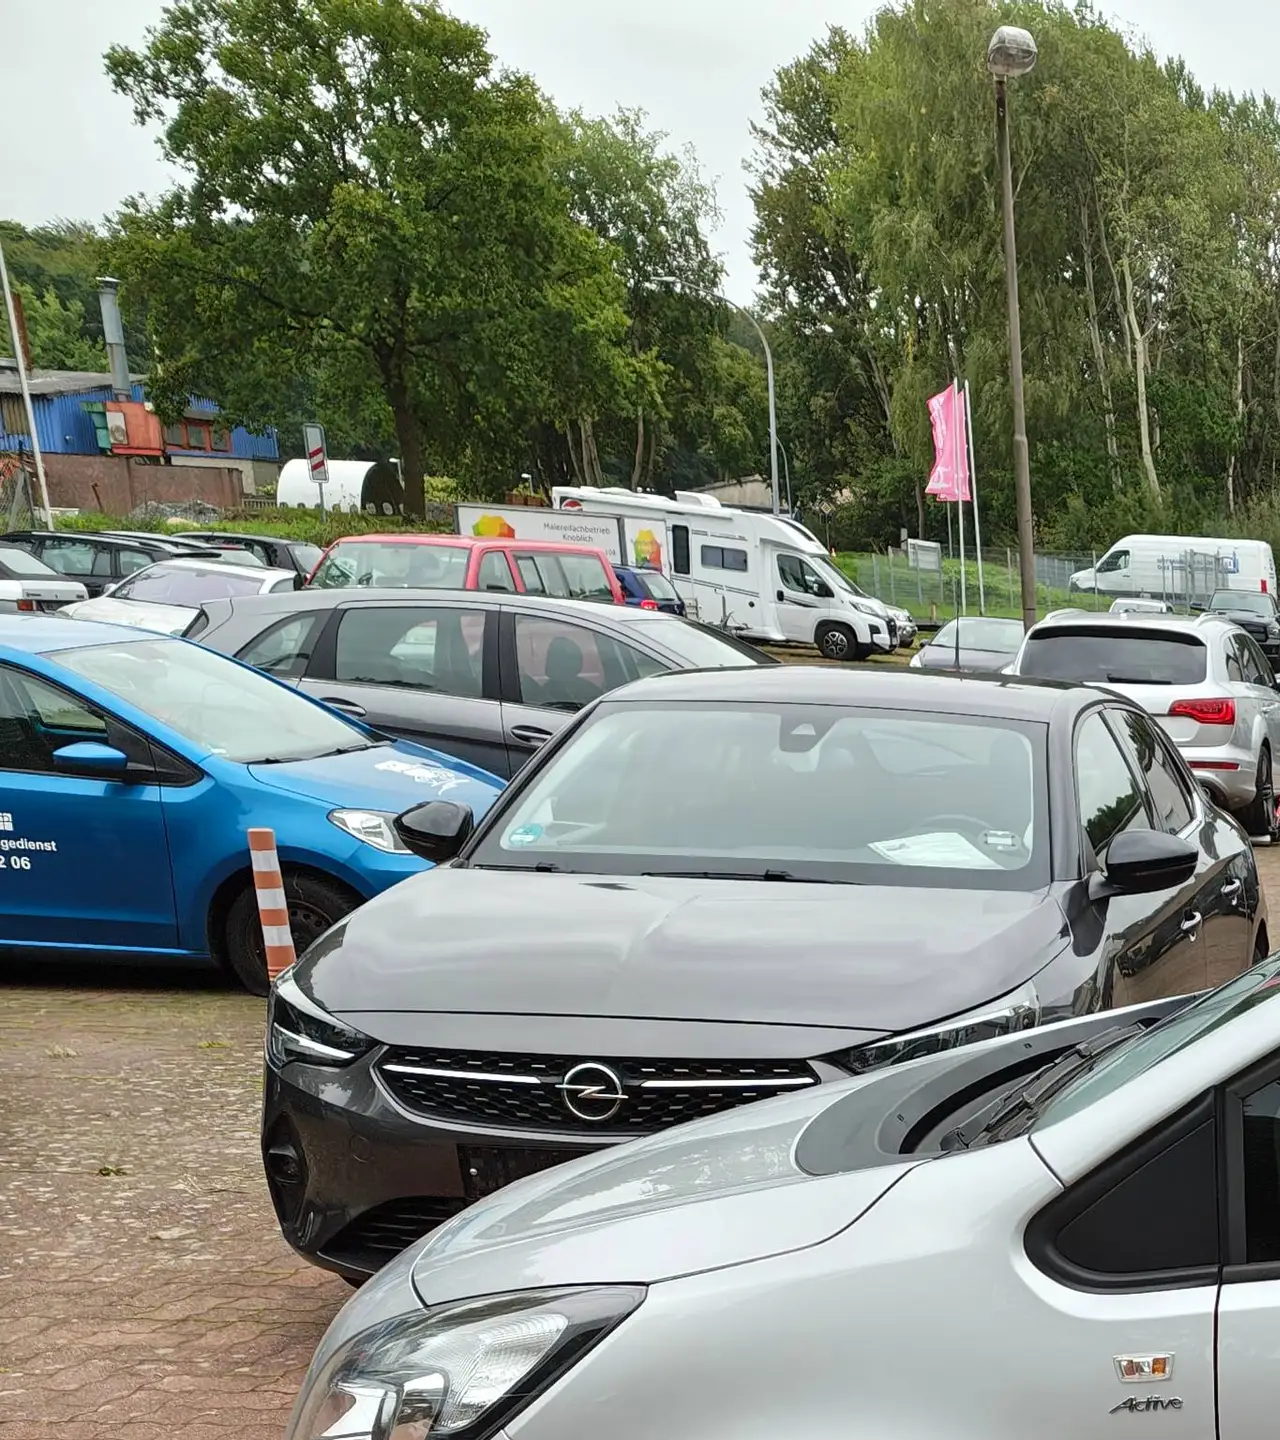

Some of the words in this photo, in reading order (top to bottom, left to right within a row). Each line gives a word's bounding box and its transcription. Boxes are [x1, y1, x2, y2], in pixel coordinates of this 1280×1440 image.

[1, 838, 57, 851] gedienst
[11, 856, 31, 869] 06
[1108, 1394, 1184, 1415] Active
